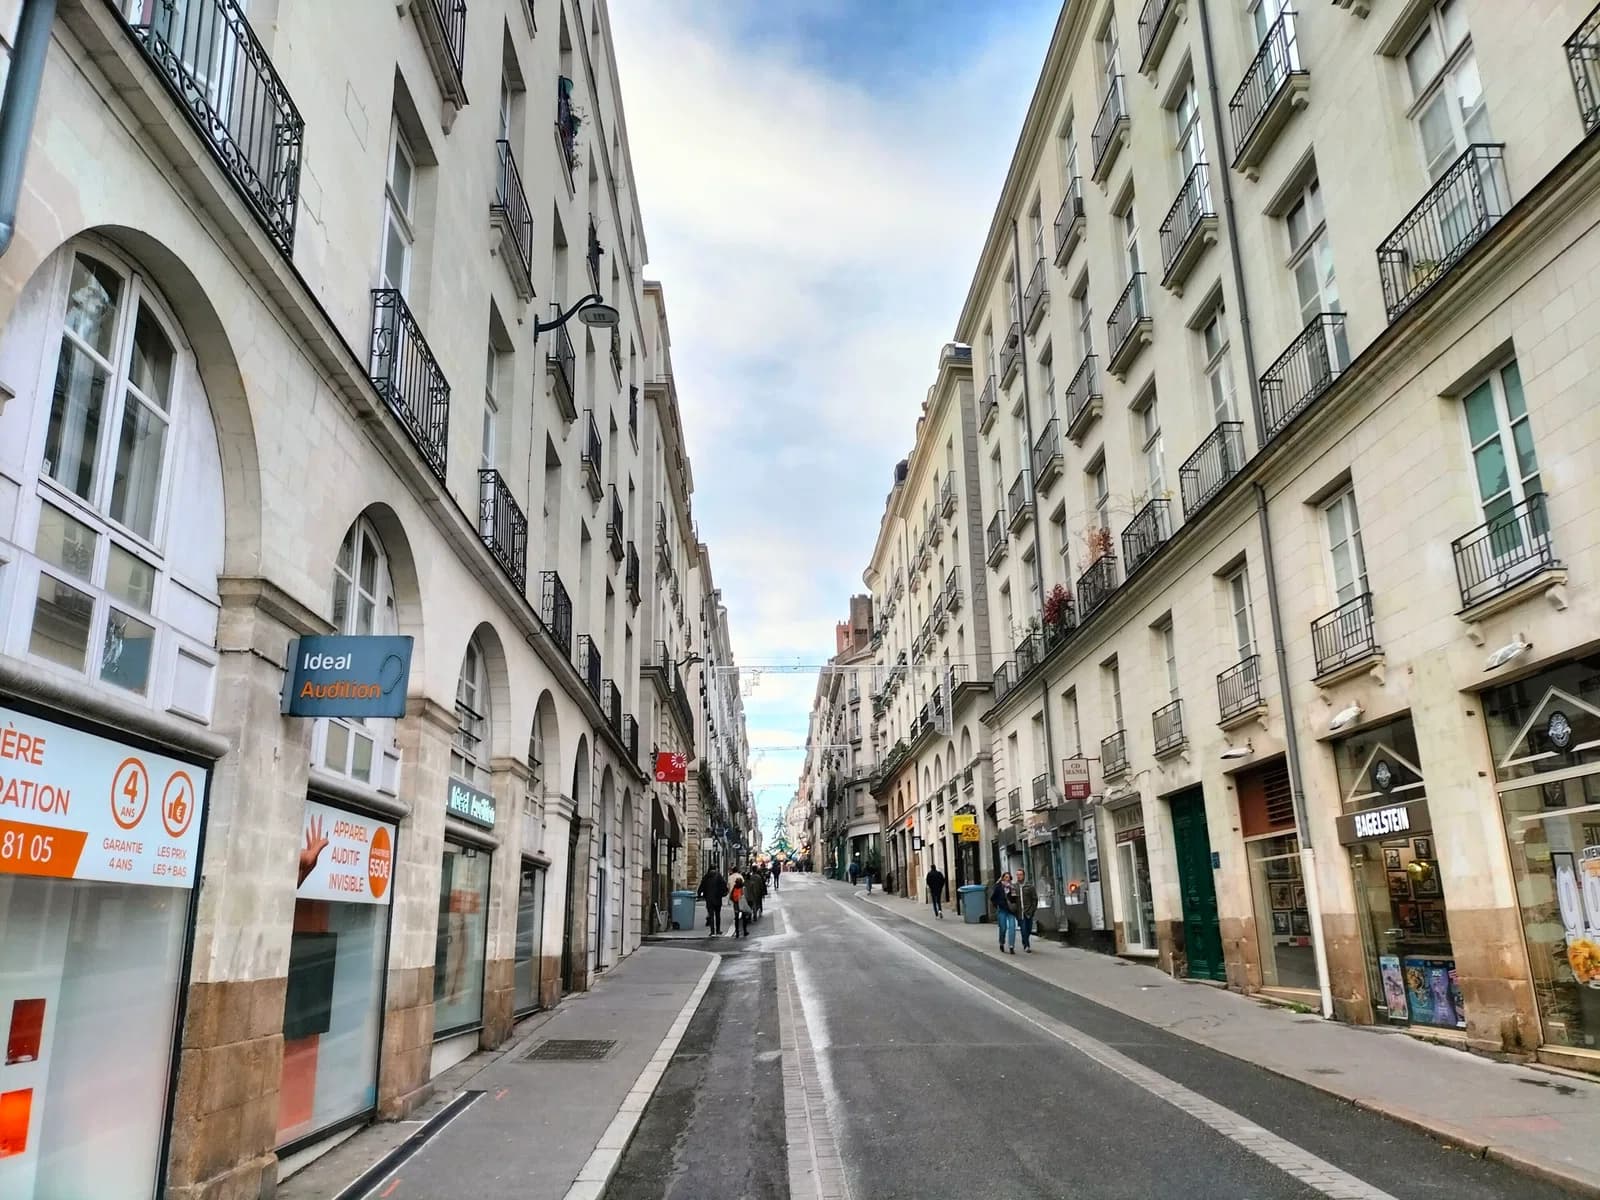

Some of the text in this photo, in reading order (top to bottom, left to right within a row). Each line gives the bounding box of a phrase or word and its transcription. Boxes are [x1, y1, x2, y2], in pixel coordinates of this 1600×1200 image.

[303, 652, 352, 670] Ideal
[300, 680, 381, 699] Audition
[0, 721, 46, 766] ÈRE
[123, 769, 139, 804] 4
[120, 806, 136, 818] ANS
[333, 820, 369, 843] APPAREIL
[1354, 807, 1410, 838] BAGELSTEIN
[1, 830, 54, 864] 81 05
[102, 837, 144, 855] GARANTIE
[157, 846, 187, 860] LES PRIX
[331, 846, 361, 866] AUDITIF
[108, 857, 133, 871] 4 ANS
[152, 863, 166, 876] LES
[172, 866, 187, 877] BAS
[369, 858, 390, 879] 550€
[328, 872, 364, 893] INVISIBLE
